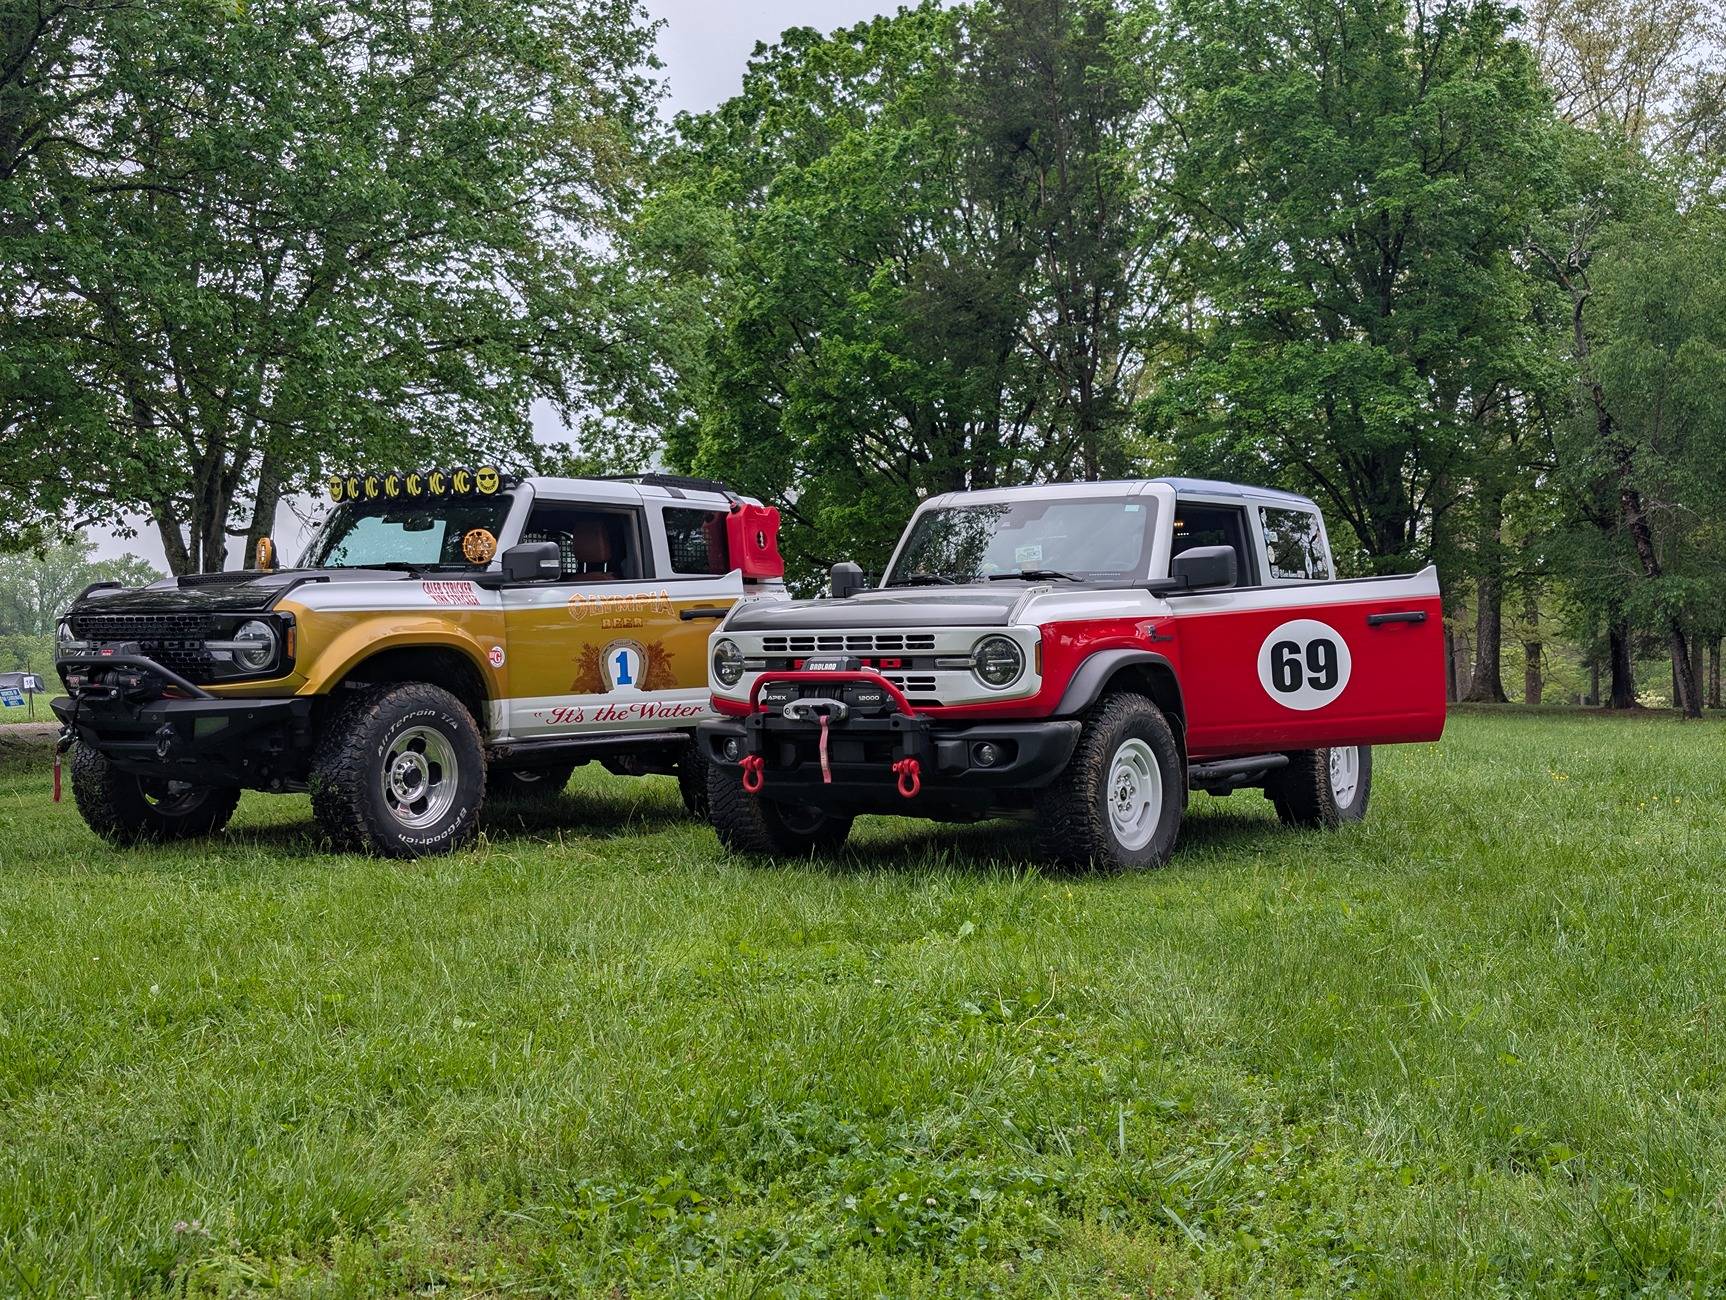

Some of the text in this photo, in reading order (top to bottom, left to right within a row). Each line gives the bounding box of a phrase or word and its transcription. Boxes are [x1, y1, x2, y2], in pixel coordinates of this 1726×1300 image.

[347, 477, 359, 499] KC
[365, 475, 379, 499] KC
[385, 474, 400, 497] KC
[406, 473, 422, 496] KC
[429, 472, 445, 496] KC
[453, 470, 470, 494] KC
[567, 588, 676, 622] OLYMPIA
[601, 617, 644, 630] BEER
[615, 650, 633, 686] 1
[809, 663, 837, 671] BADLAND
[1270, 638, 1339, 693] 69
[441, 712, 458, 730] T/A
[591, 703, 629, 722] the
[630, 701, 703, 719] Water
[398, 807, 467, 846] BFGoodrich
